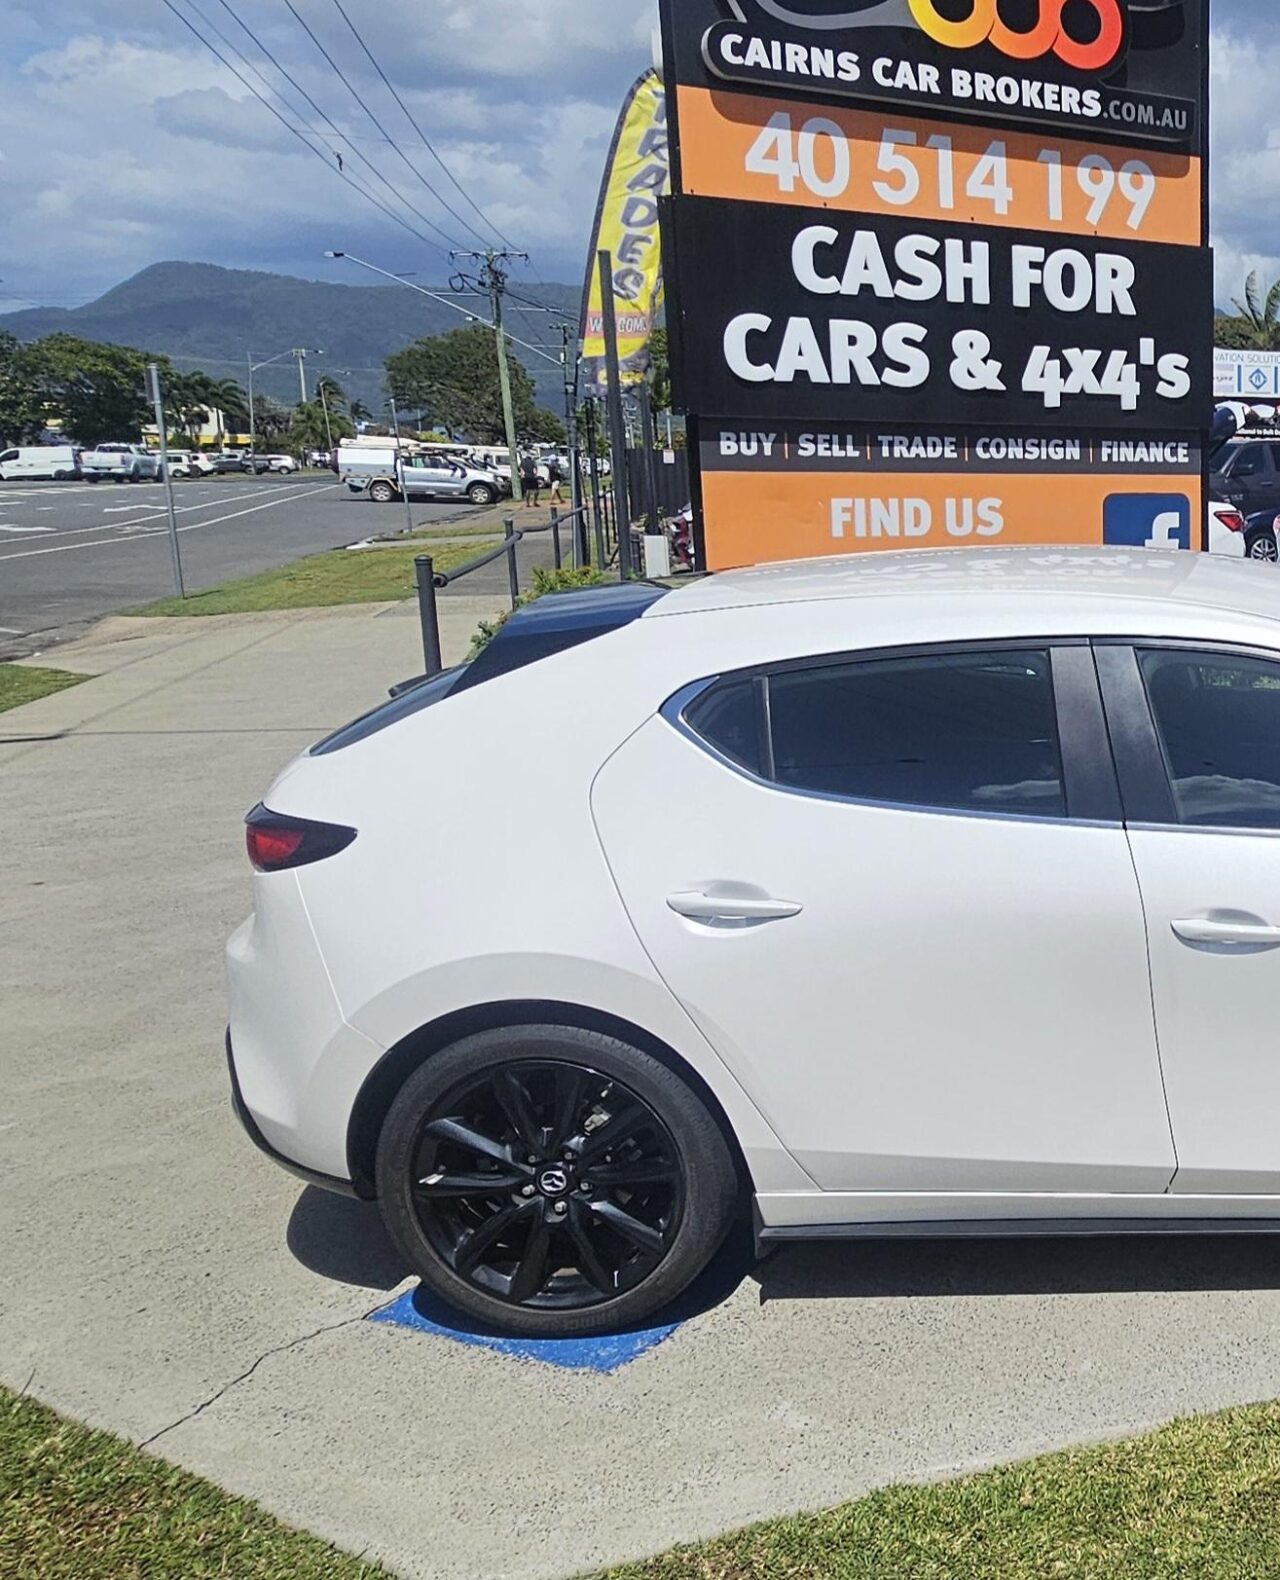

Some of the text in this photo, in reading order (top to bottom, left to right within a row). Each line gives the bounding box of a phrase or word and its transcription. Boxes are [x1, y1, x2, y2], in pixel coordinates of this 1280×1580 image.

[720, 33, 861, 82] CAIRNS
[872, 57, 941, 94] CAR
[743, 111, 1158, 231] 40 514 199
[791, 225, 1137, 316] CASH FOR
[589, 317, 647, 332] WCOM
[723, 312, 930, 388] CARS
[949, 329, 1007, 391] &
[719, 432, 1190, 464] BUY SELL TRADE CONSIGN FINANCE
[830, 496, 1004, 538] FIND US
